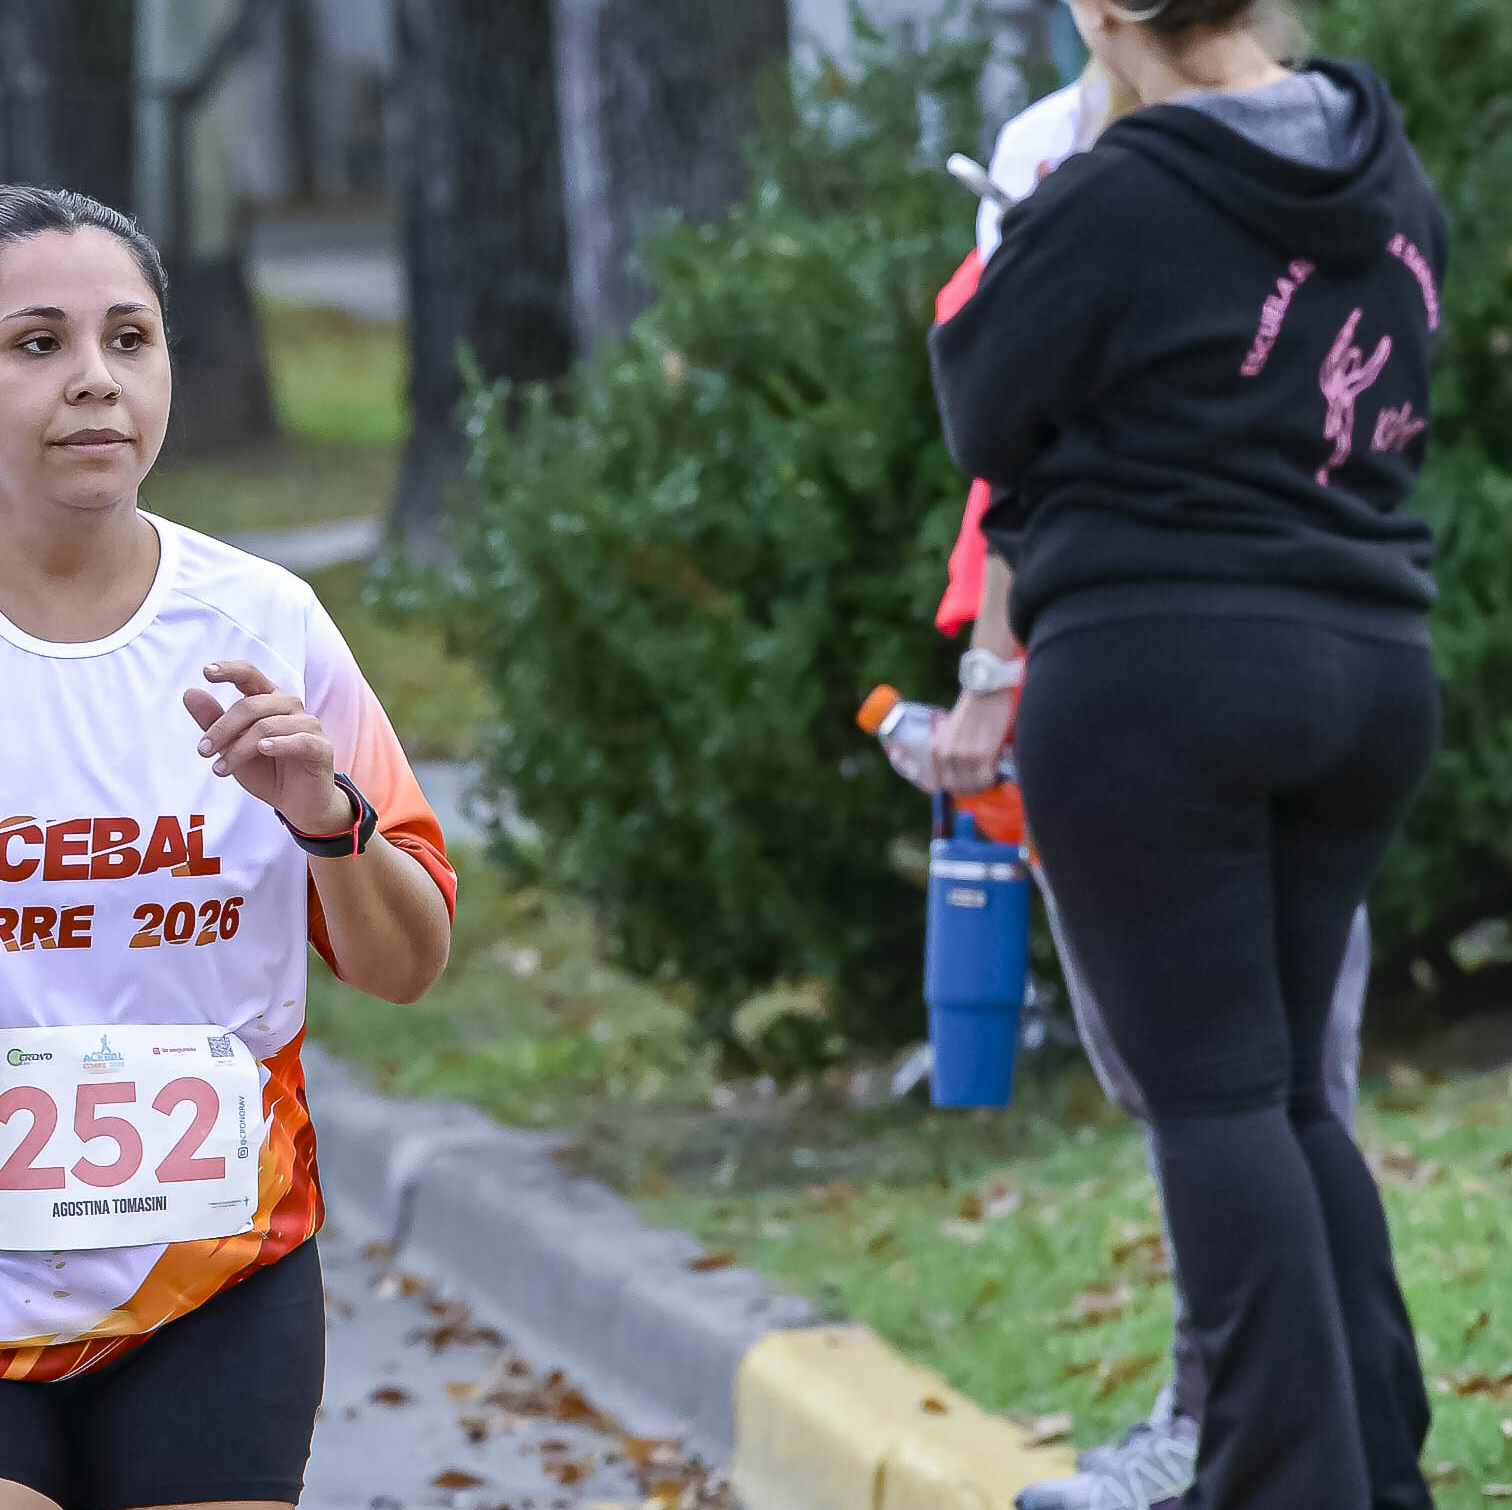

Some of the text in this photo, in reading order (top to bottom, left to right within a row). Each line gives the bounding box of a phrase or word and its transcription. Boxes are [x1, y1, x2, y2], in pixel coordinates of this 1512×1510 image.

[128, 895, 244, 949] 2026
[52, 1195, 168, 1218] AGOSTINA TOMASINI
